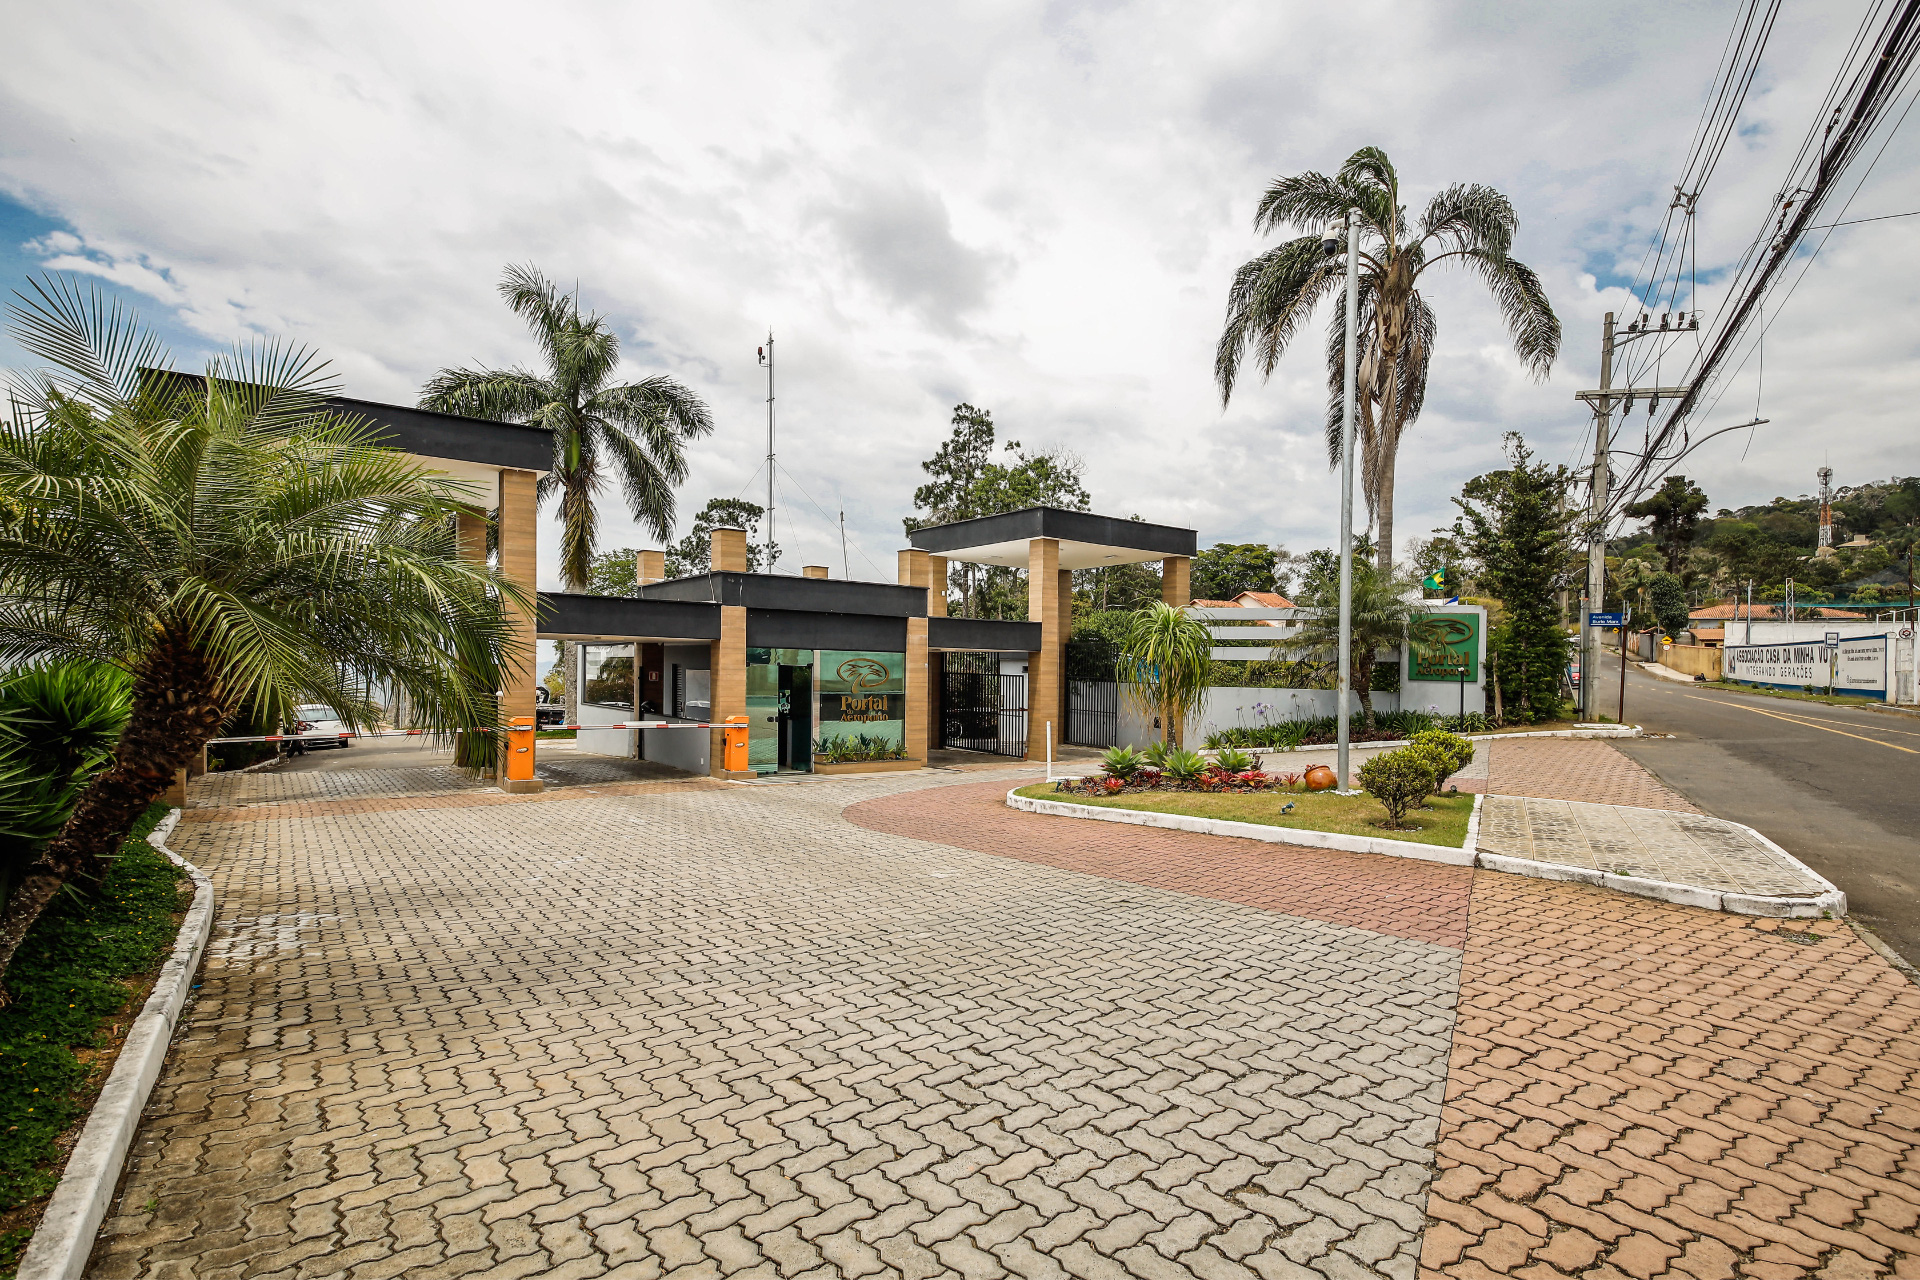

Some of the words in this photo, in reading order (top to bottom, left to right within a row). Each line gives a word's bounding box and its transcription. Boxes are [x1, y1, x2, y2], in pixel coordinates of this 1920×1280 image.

[1417, 651, 1470, 666] Portal
[1765, 648, 1781, 664] CASA
[1782, 648, 1792, 664] DA
[1793, 646, 1815, 664] MINHA
[1416, 666, 1471, 677] Aeroporo
[1745, 665, 1776, 677] INTEGRANDO
[1780, 664, 1813, 680] GERAÇÕES
[841, 694, 888, 711] Portal
[840, 712, 889, 724] Aeroporto
